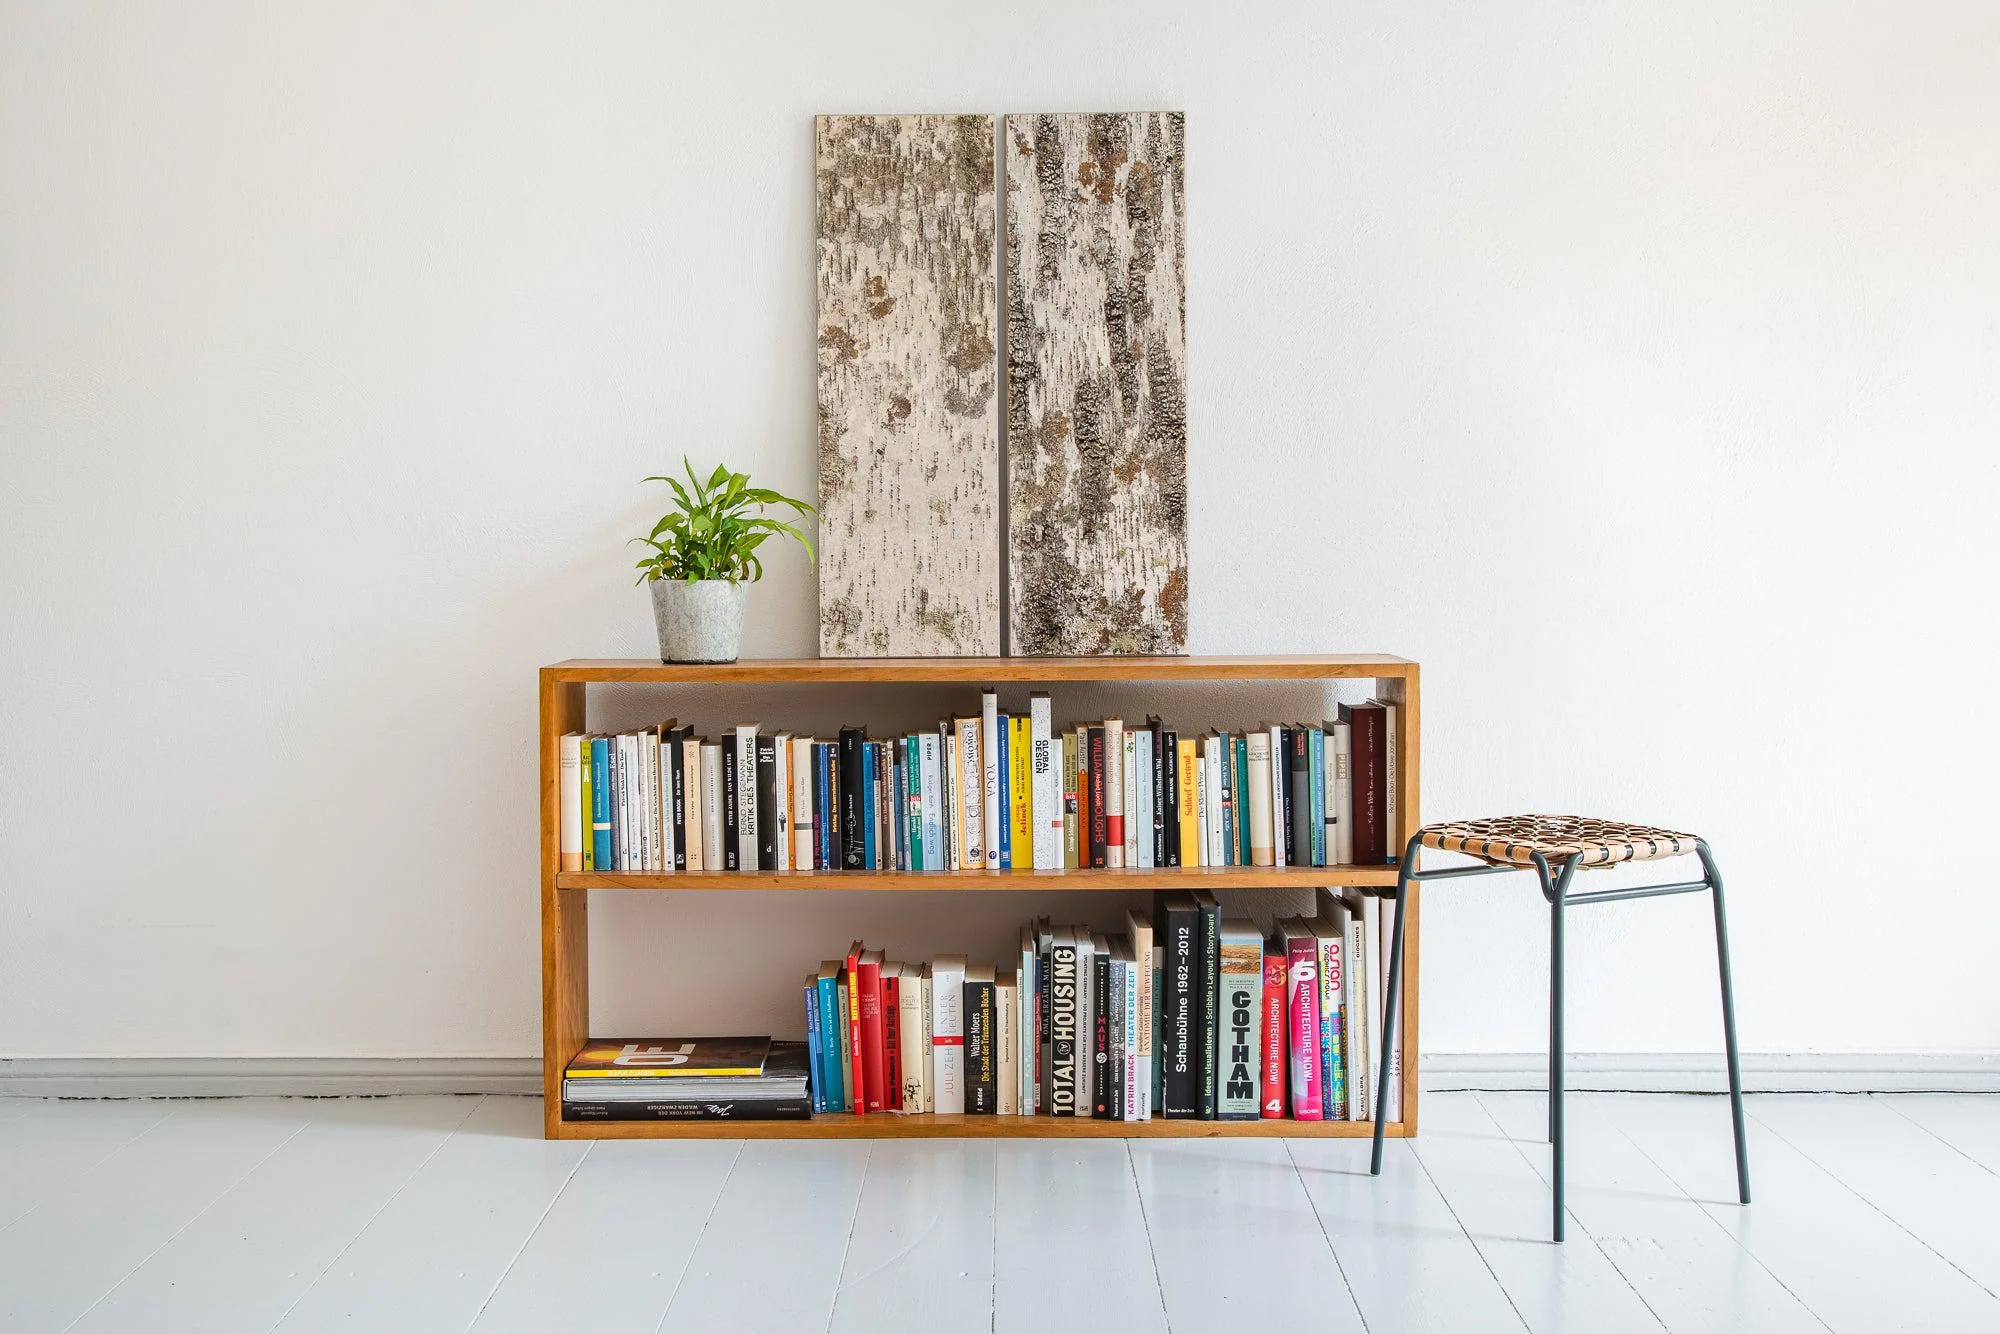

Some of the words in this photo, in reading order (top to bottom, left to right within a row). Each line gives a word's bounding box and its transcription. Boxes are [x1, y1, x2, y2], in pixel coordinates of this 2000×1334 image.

[1080, 732, 1088, 745] Paul
[746, 737, 754, 784] THEATERS
[1080, 746, 1088, 764] Auster
[986, 763, 996, 798] YOGA
[1184, 756, 1192, 785] Gertrud
[1184, 789, 1192, 816] Schleef
[928, 813, 936, 838] Endlich
[928, 840, 936, 854] weg
[1206, 960, 1214, 985] Layout
[1329, 944, 1341, 991] asian
[849, 972, 857, 997] LERNEN
[980, 987, 989, 1007] Bücher
[1053, 949, 1075, 1040] HOUSING
[1206, 990, 1214, 1020] Scribble
[971, 1012, 980, 1034] Moers
[980, 1008, 989, 1044] Träumenden
[1269, 998, 1280, 1060] ARCHITECTURE
[1301, 983, 1312, 1054] ARCHITECTURE
[970, 1035, 980, 1056] Walter
[1097, 1016, 1106, 1051] MAUS
[1176, 998, 1187, 1073] Schaubühne
[1226, 991, 1254, 1100] GOTHAM
[944, 1048, 953, 1069] ZEH
[981, 1046, 989, 1055] der
[1204, 1027, 1212, 1074] visualisieren
[981, 1056, 989, 1071] Stadt
[1270, 1062, 1280, 1085] NOW!
[1302, 1056, 1313, 1082] NOW!
[944, 1073, 954, 1096] JULI
[981, 1072, 990, 1082] Die
[1053, 1054, 1074, 1114] TOTAL
[1204, 1076, 1212, 1096] ideen
[1265, 1099, 1282, 1113] 4
